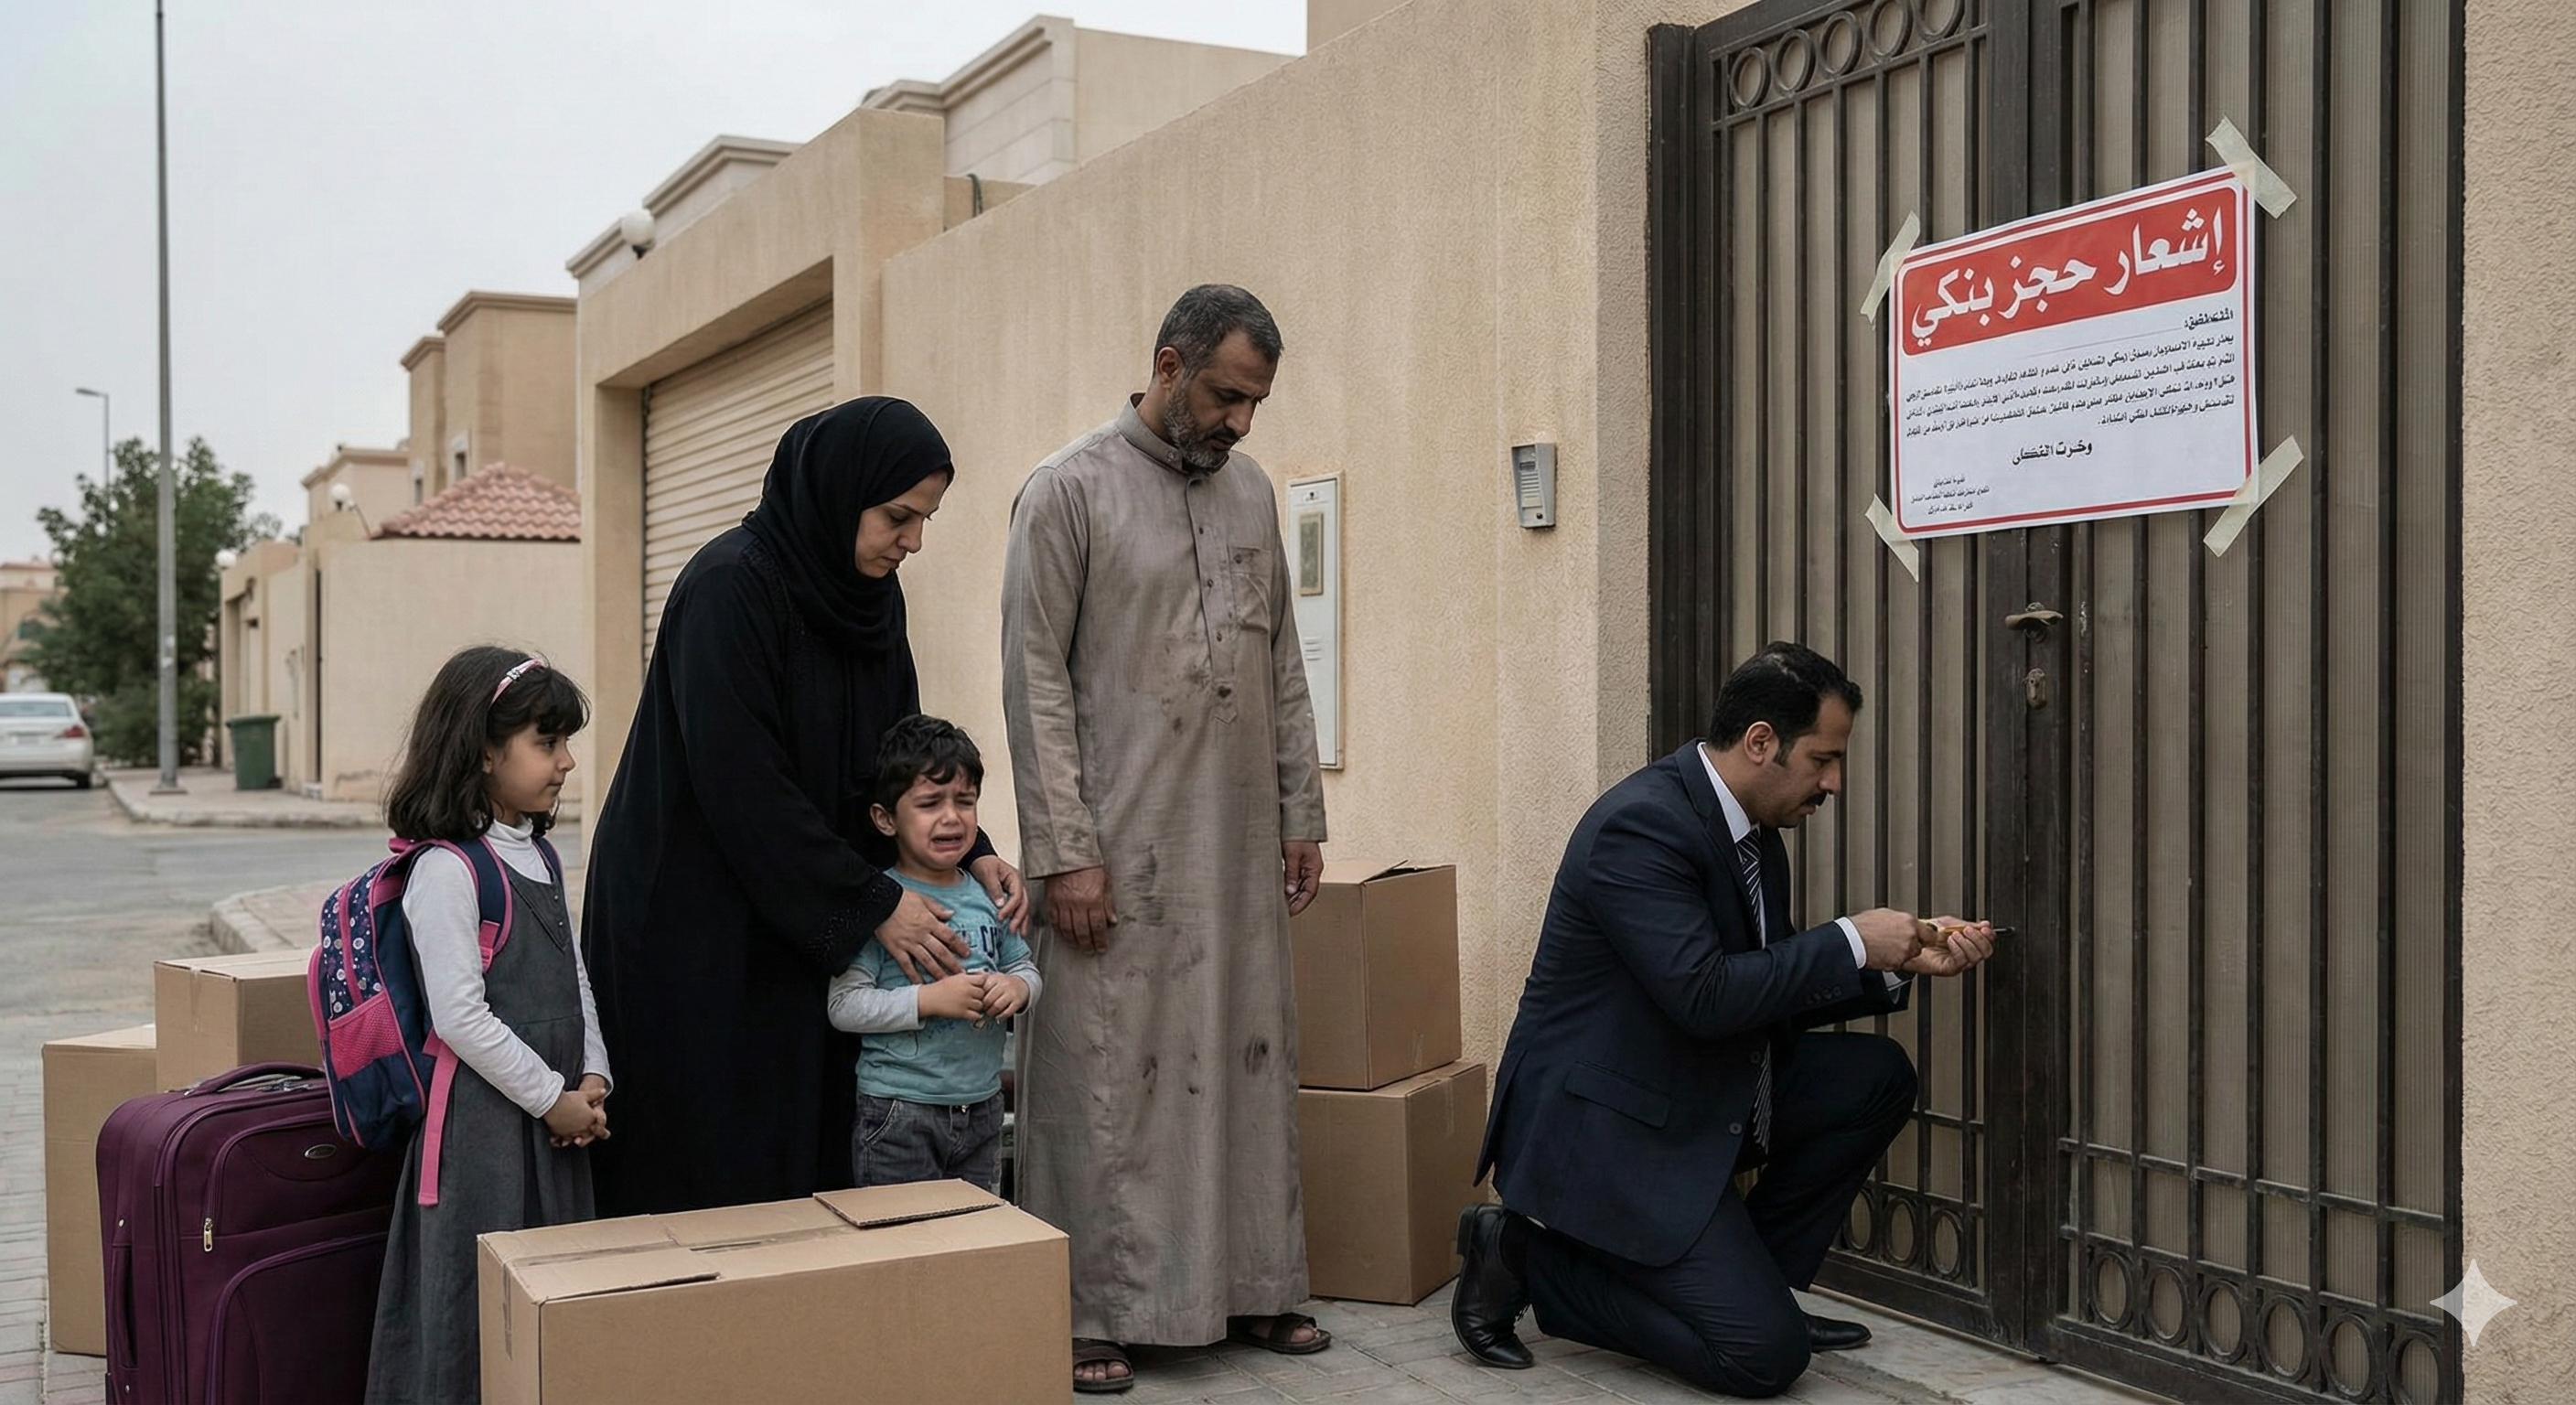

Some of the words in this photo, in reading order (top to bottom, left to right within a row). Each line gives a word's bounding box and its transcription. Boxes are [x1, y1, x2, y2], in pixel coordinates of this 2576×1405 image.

[1998, 255, 2098, 319] حجز
[2104, 206, 2226, 295] إشعار
[1910, 267, 1995, 348] بنكي
